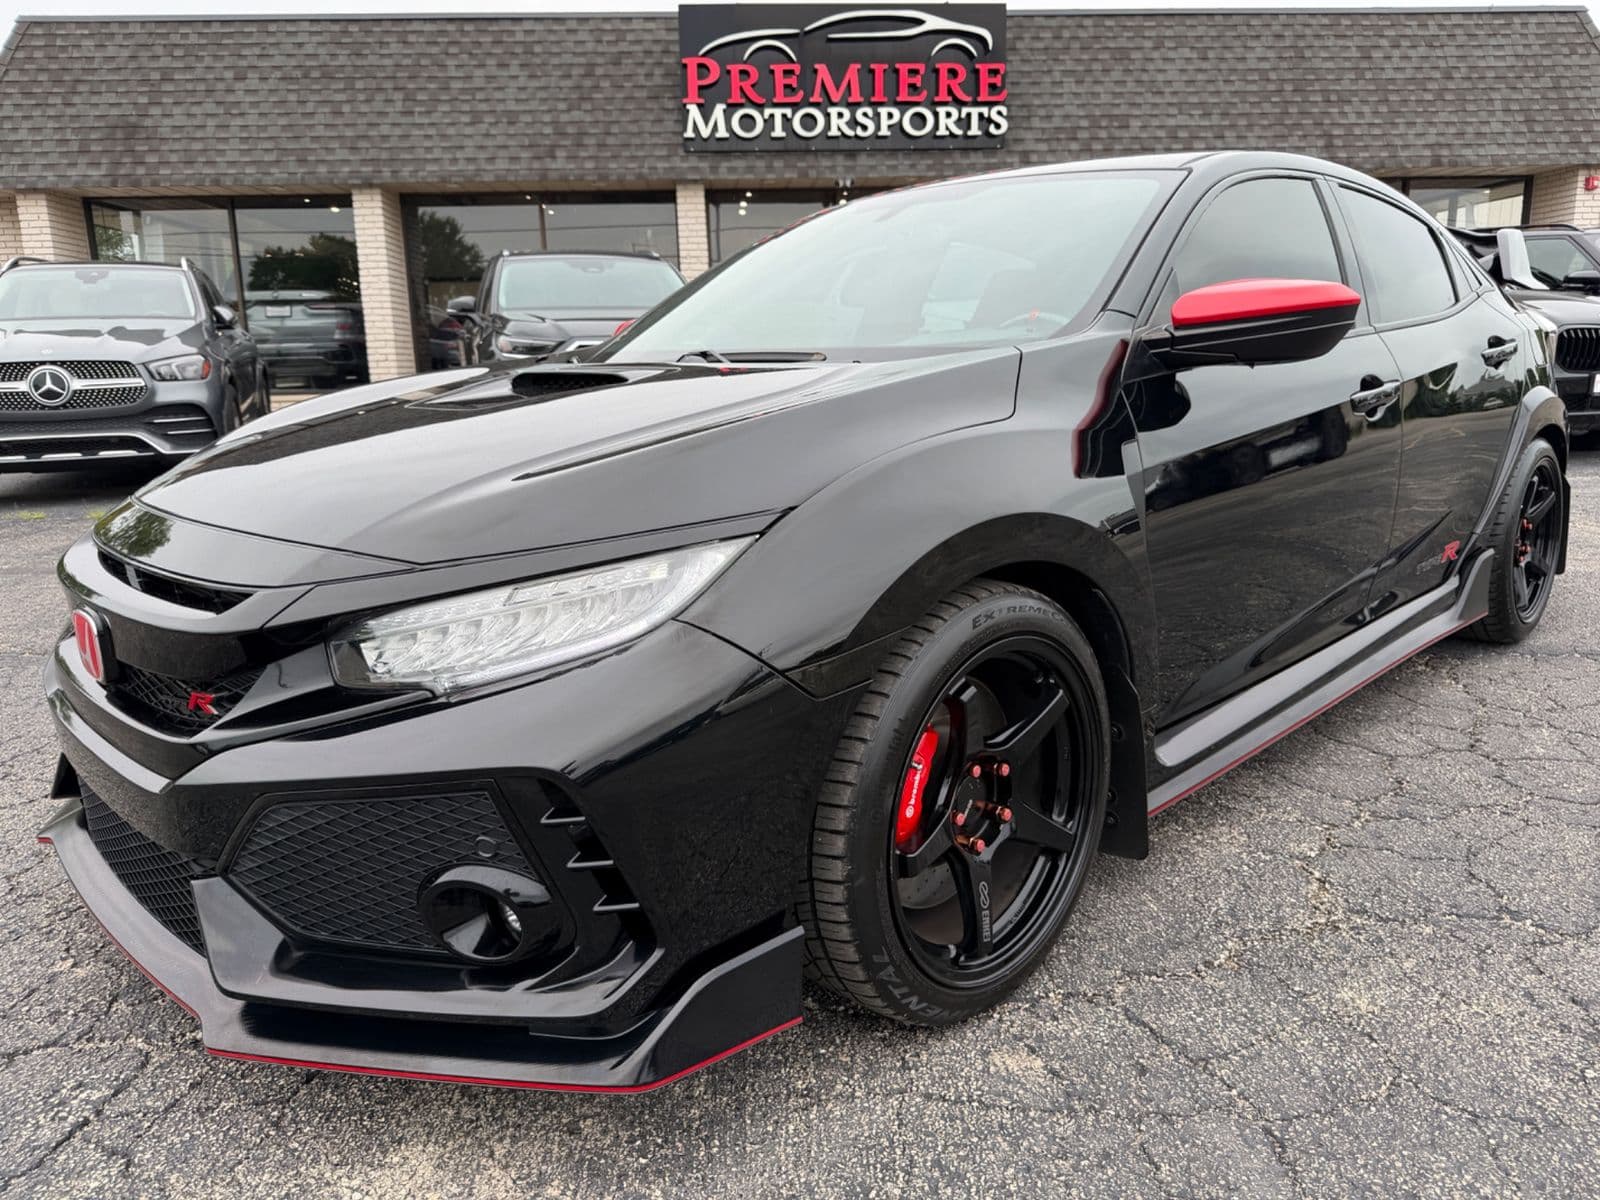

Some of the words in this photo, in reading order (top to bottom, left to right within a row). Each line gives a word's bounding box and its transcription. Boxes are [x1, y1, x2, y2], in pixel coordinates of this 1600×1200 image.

[681, 56, 1008, 104] PREMIERE
[683, 103, 1008, 138] MOTORSPORTS
[188, 692, 216, 714] R
